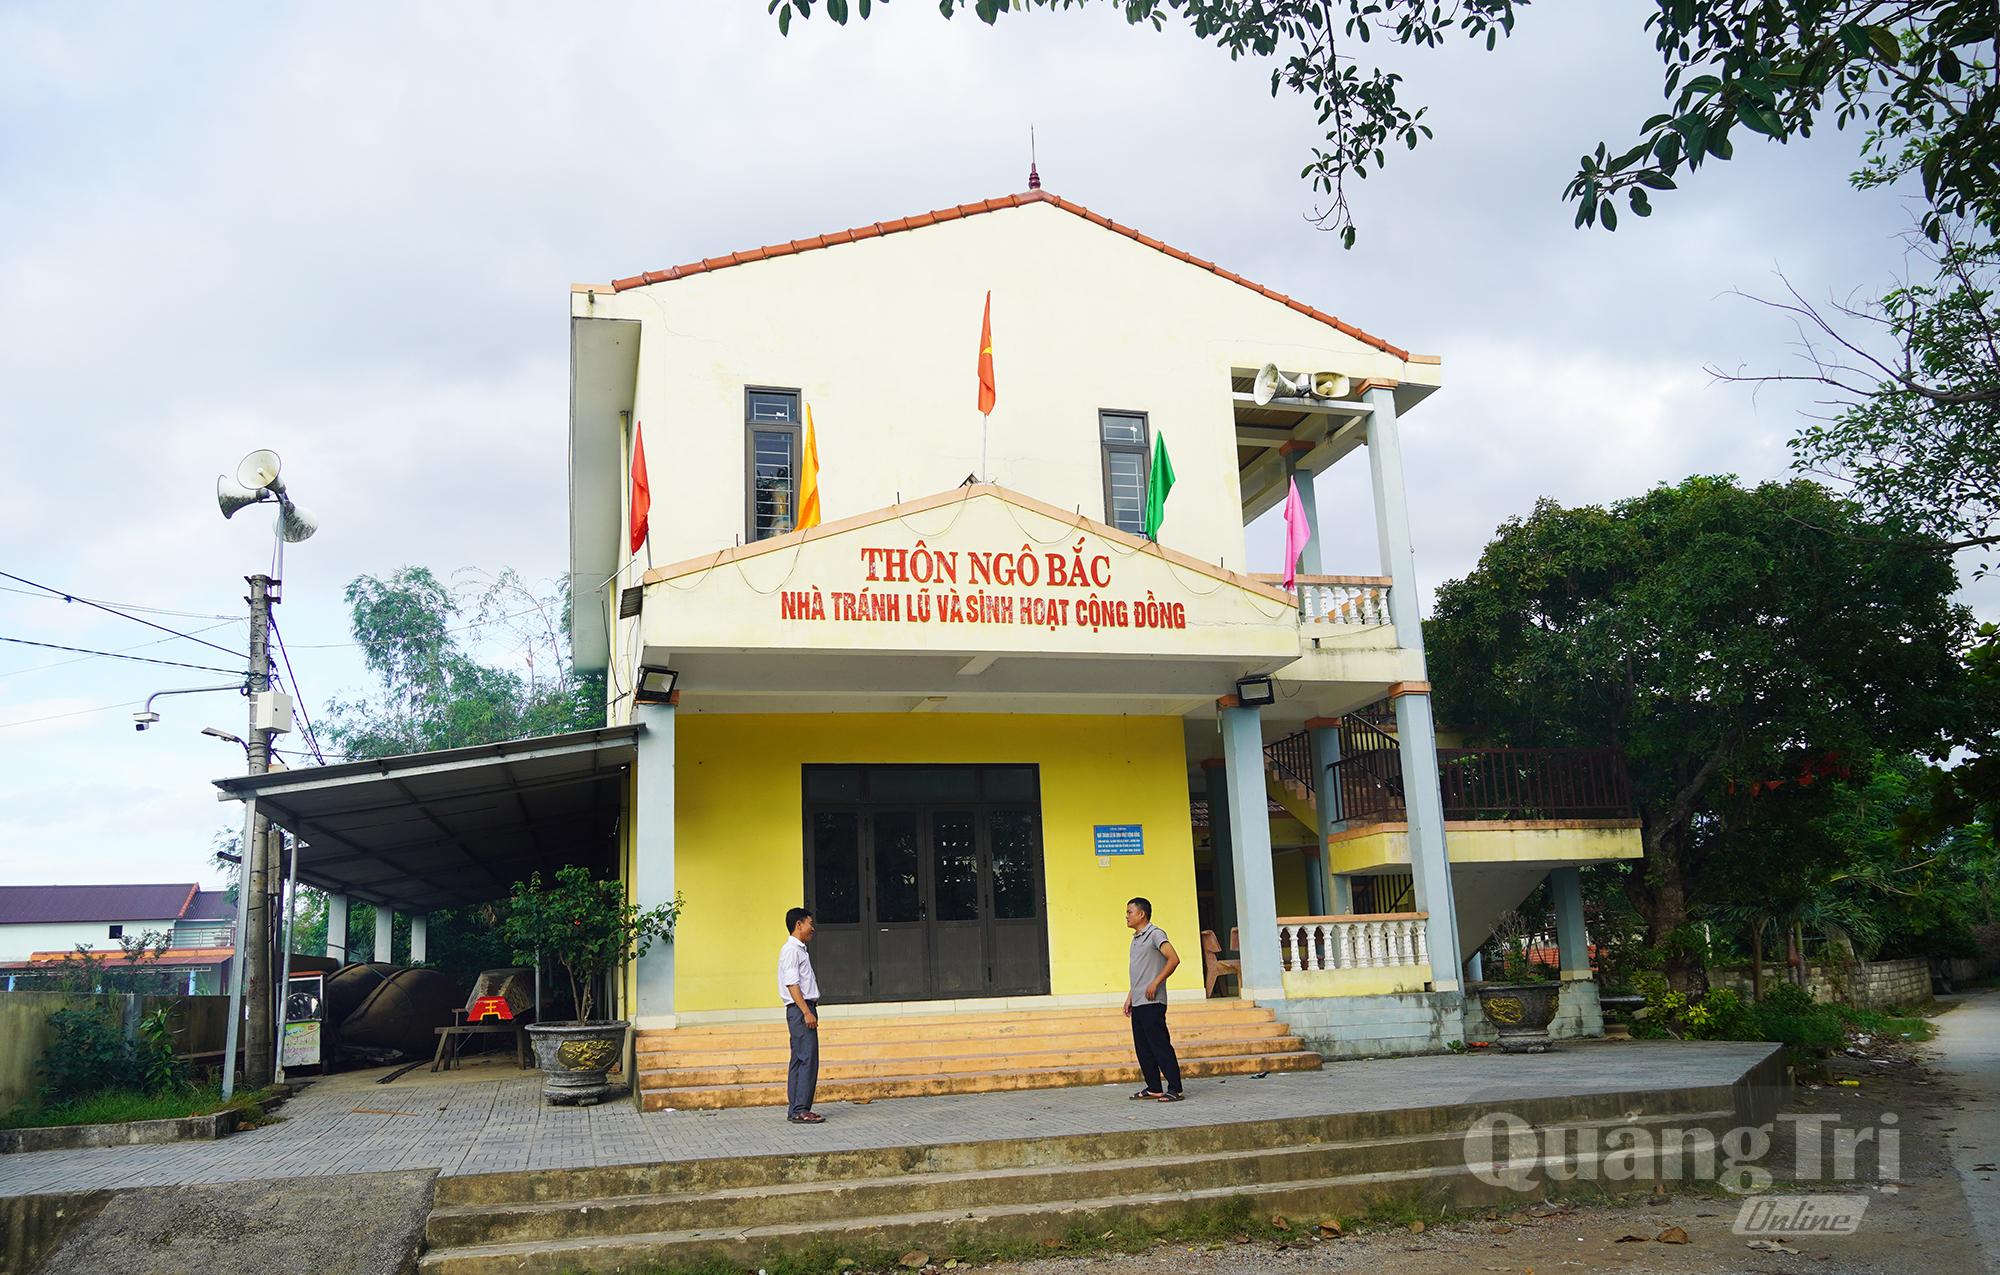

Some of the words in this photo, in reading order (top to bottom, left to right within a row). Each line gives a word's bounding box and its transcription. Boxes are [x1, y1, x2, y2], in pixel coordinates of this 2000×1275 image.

[861, 539, 958, 584] THÔN
[968, 543, 1040, 586] NGÔ
[1045, 536, 1111, 588] BẮC
[781, 585, 826, 620] NHÀ
[831, 587, 900, 622] TRÁNH
[906, 588, 931, 623] LŨ
[937, 588, 964, 623] VÀ
[1020, 596, 1069, 631] HOẠT
[1075, 593, 1128, 633] CỘNG
[1134, 590, 1186, 629] ĐỒNG
